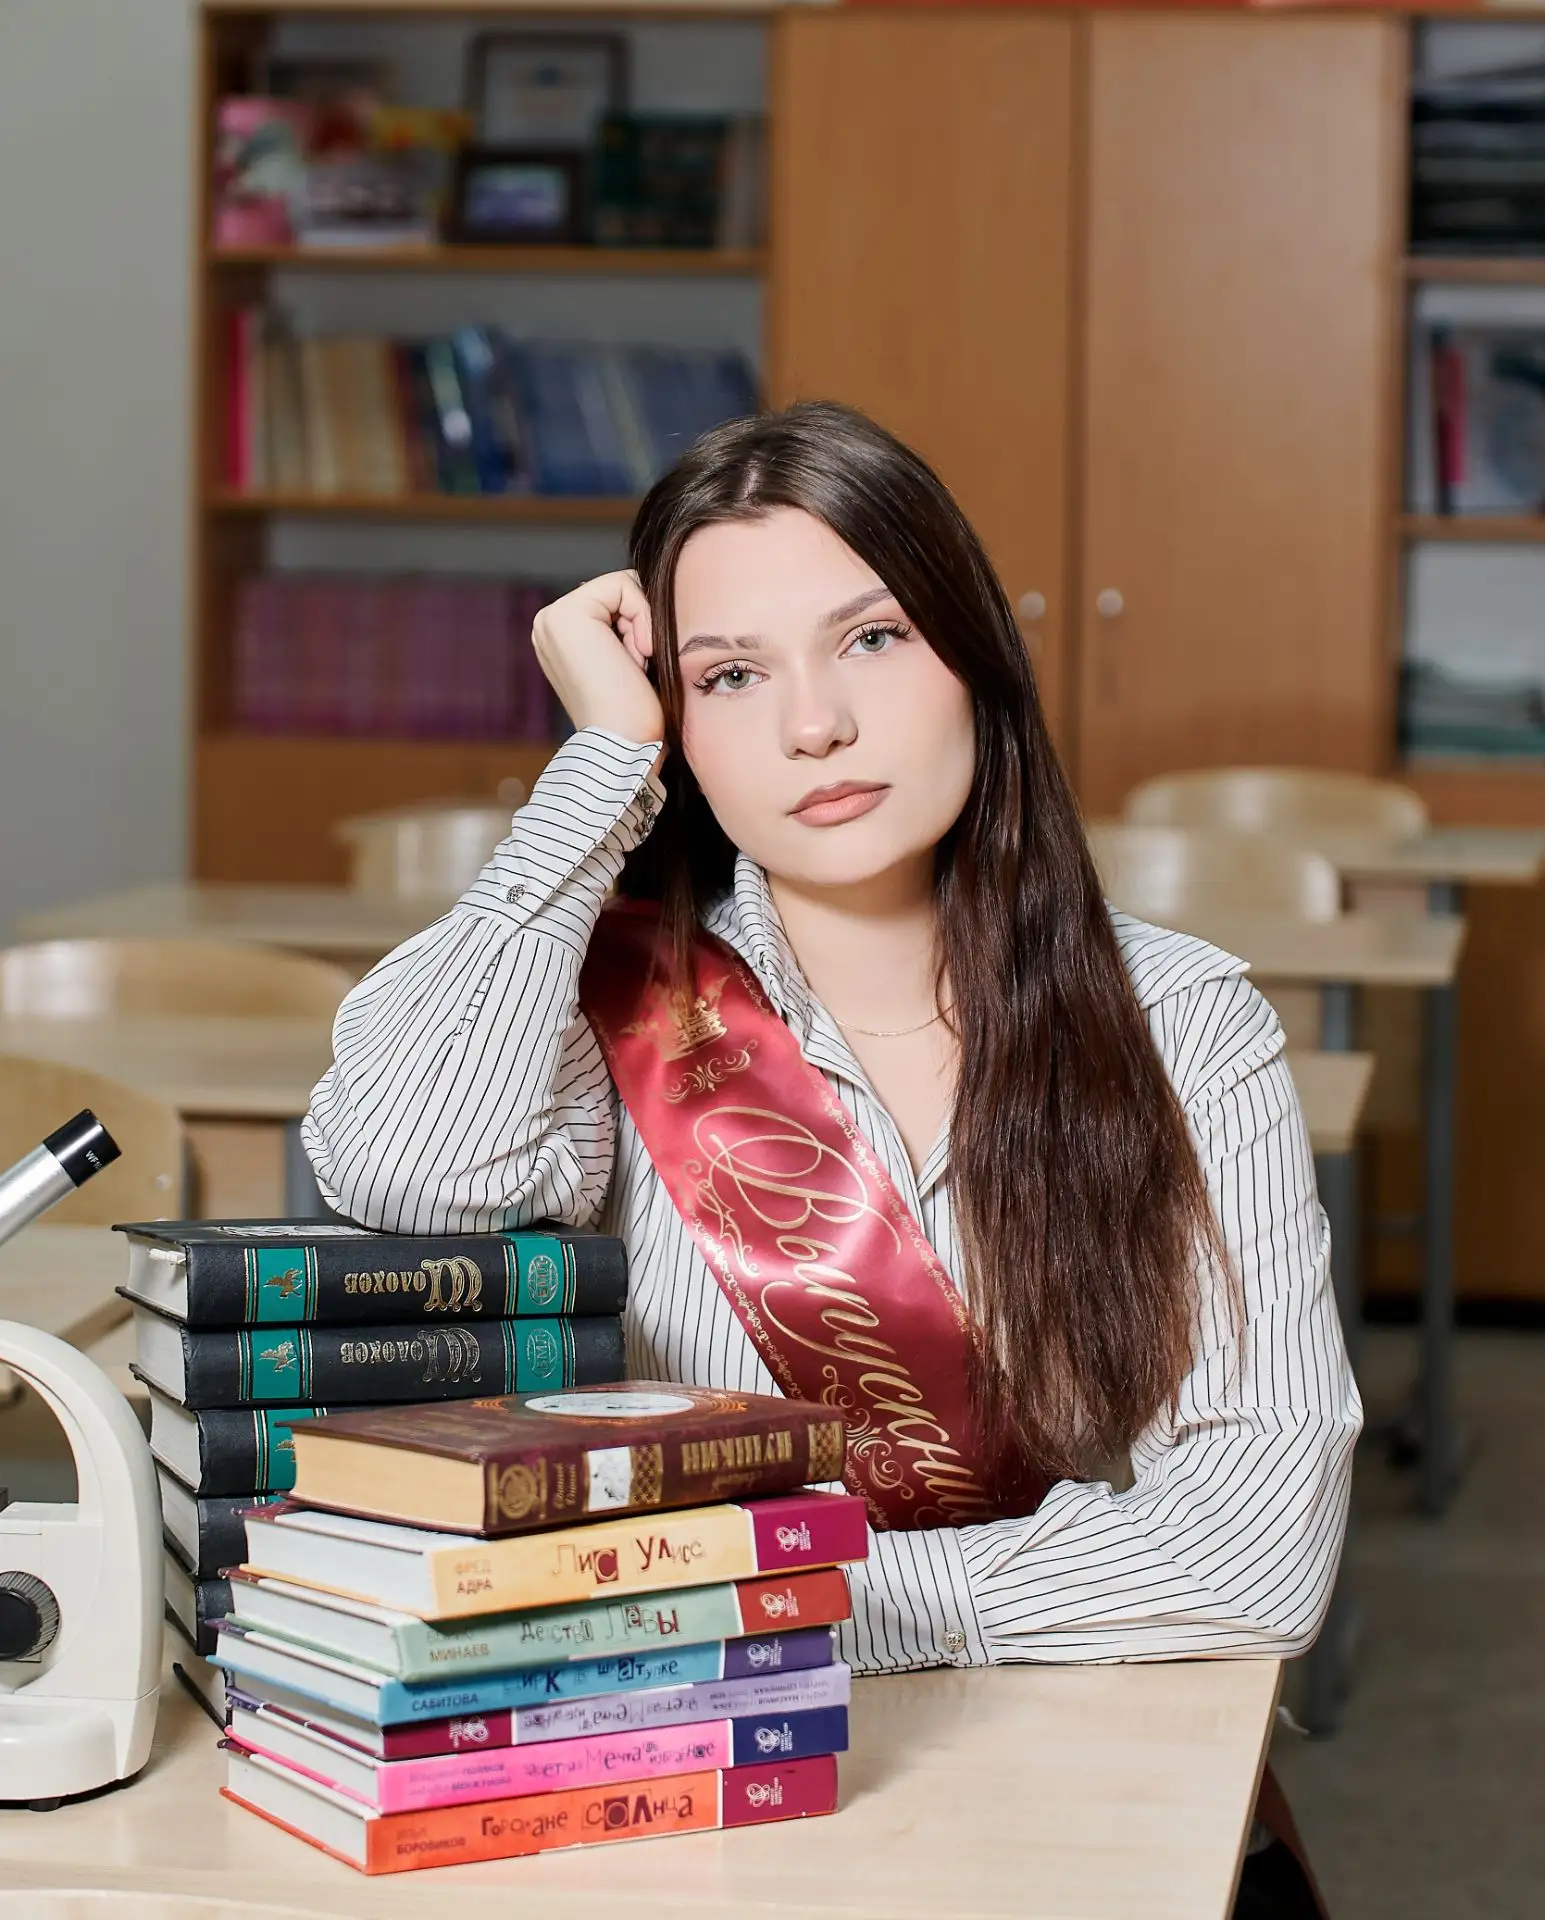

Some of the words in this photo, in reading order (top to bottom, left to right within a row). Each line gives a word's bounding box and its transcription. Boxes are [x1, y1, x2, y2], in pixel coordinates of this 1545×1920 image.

[343, 1255, 483, 1312] Шолохов
[340, 1327, 483, 1383] Шолохов
[681, 1430, 793, 1475] ПУШКИН
[456, 1577, 493, 1595] АДРА
[520, 1619, 594, 1644] Дество
[430, 1643, 490, 1662] МИНАЕВ
[412, 1692, 479, 1712] САБИТОВА
